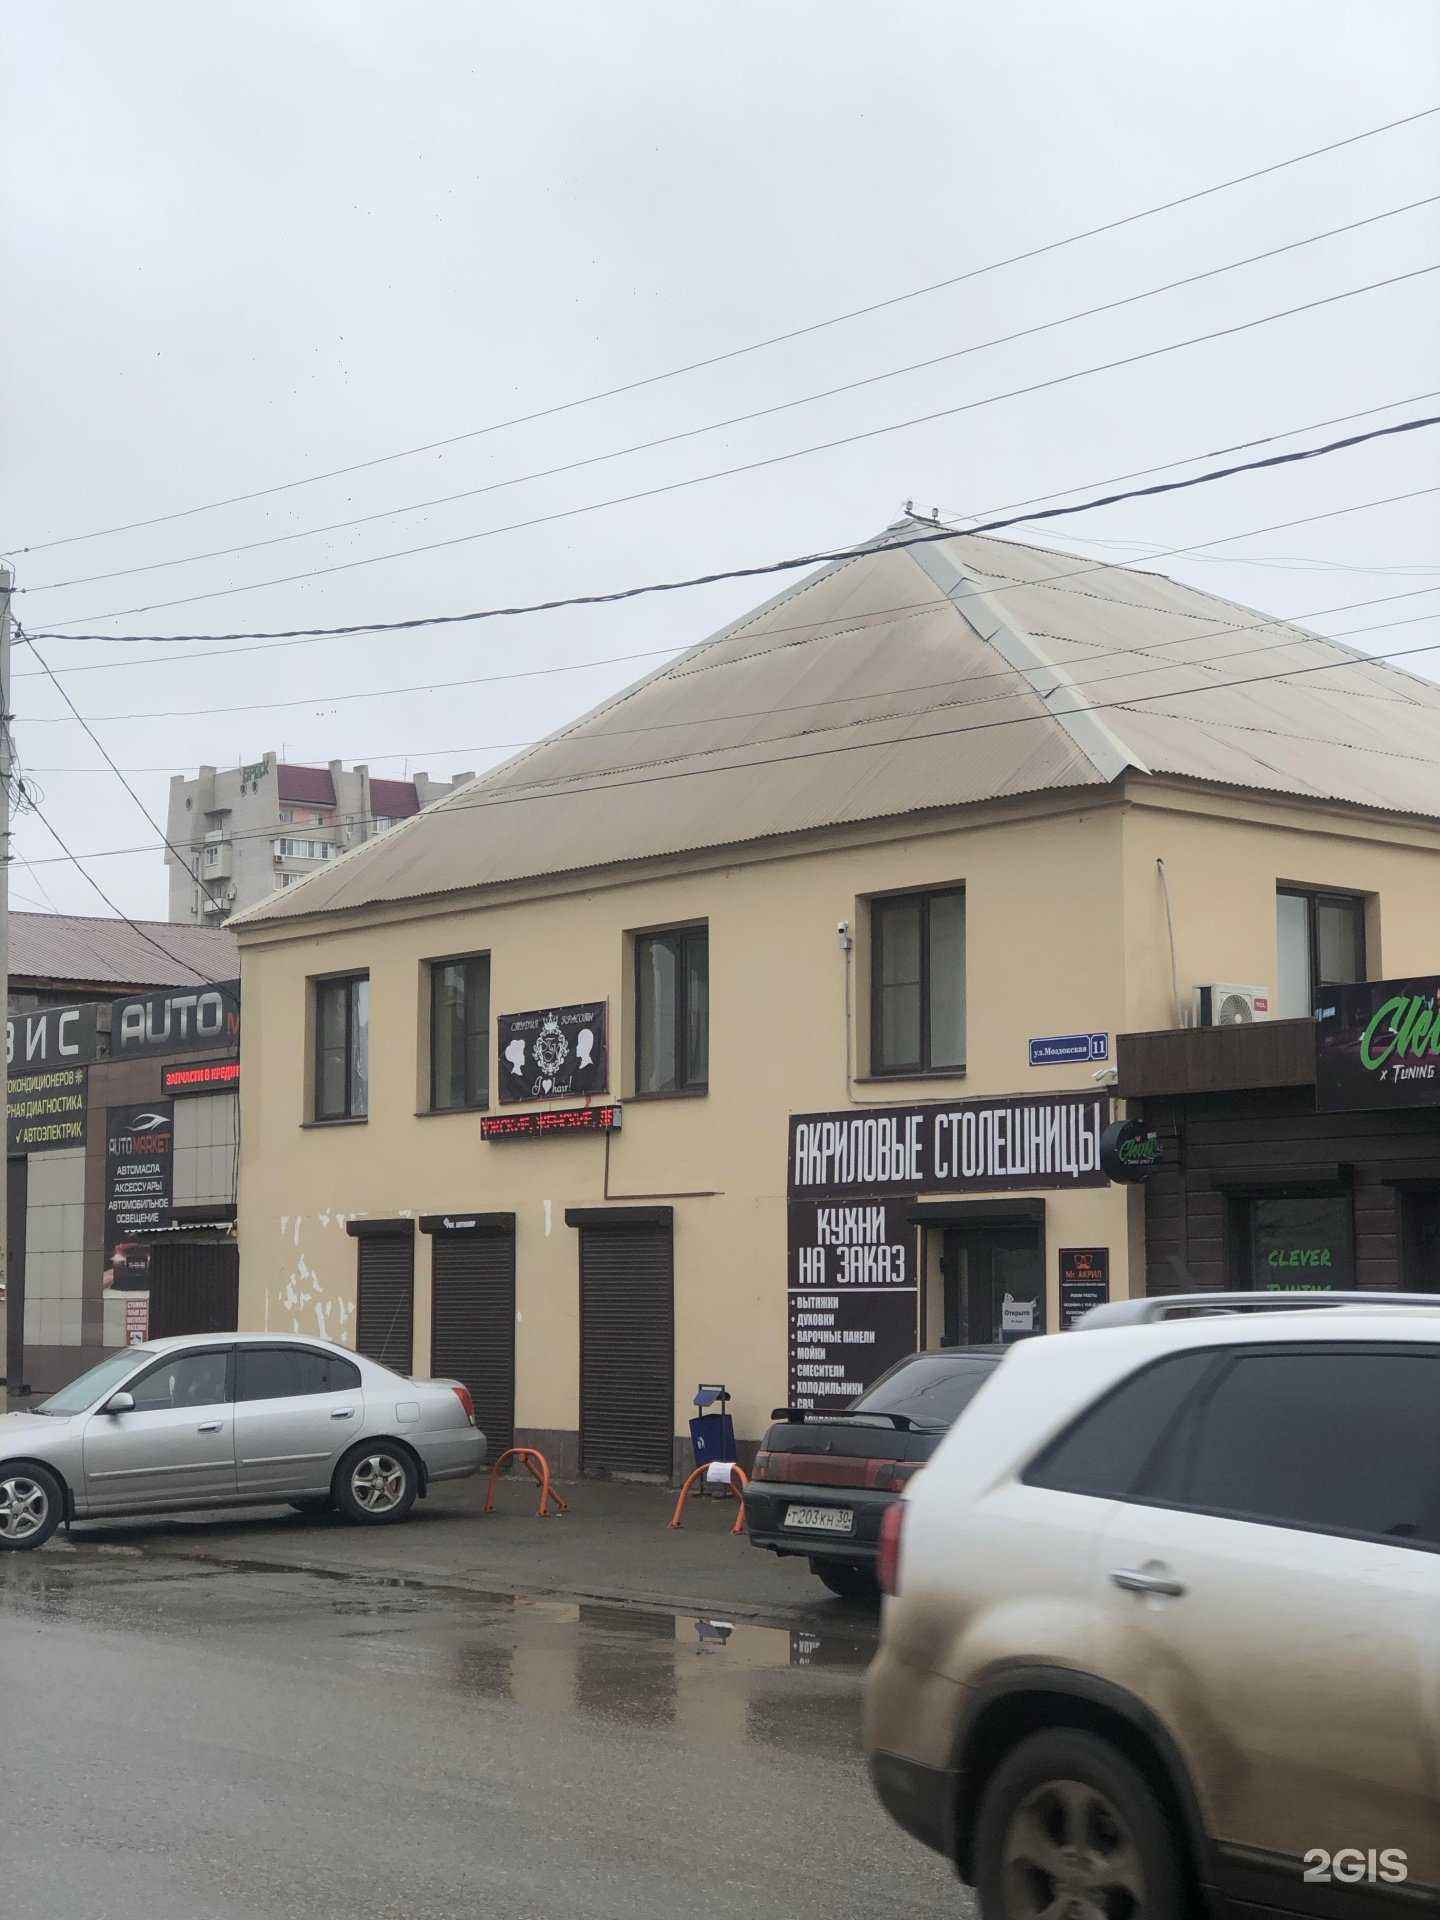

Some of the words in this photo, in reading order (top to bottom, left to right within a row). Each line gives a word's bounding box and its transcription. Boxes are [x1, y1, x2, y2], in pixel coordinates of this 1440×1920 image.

[121, 992, 223, 1048] AUTO
[1093, 1041, 1105, 1054] 11
[1393, 1065, 1435, 1084] TUNING
[26, 1095, 82, 1119] ДИАГНОСТИКА
[23, 1122, 82, 1143] АВТОЭЛЕКТРИК
[794, 1115, 924, 1186] АКРИЛОВЫЕ
[934, 1102, 1101, 1178] СТОЛЕШНИЦЫ
[117, 1164, 160, 1176] АВТОМАСЛА
[114, 1181, 163, 1193] АКСЕССУАРЫ
[108, 1198, 169, 1211] АВТОМОБИЛЬНОЕ
[116, 1213, 160, 1224] ОСВЕЩЕНИЕ
[817, 1206, 886, 1245] КУХНИ
[799, 1246, 825, 1284] НА
[836, 1244, 905, 1284] ЗАКАЗ
[1268, 1247, 1332, 1267] CLEVER
[797, 1296, 839, 1309] ВЫТЯЖКИ
[797, 1313, 835, 1328] ДУХОВКИ
[797, 1330, 842, 1343] ВАРОЧНЫЕ
[843, 1330, 876, 1344] ПАНЕЛИ
[797, 1345, 826, 1360] МОЙКИ
[797, 1364, 845, 1378] СМЕСИТЕЛИ
[797, 1381, 864, 1397] ХОЛОДИЛЬНИКИ
[797, 1398, 814, 1409] СВЧ
